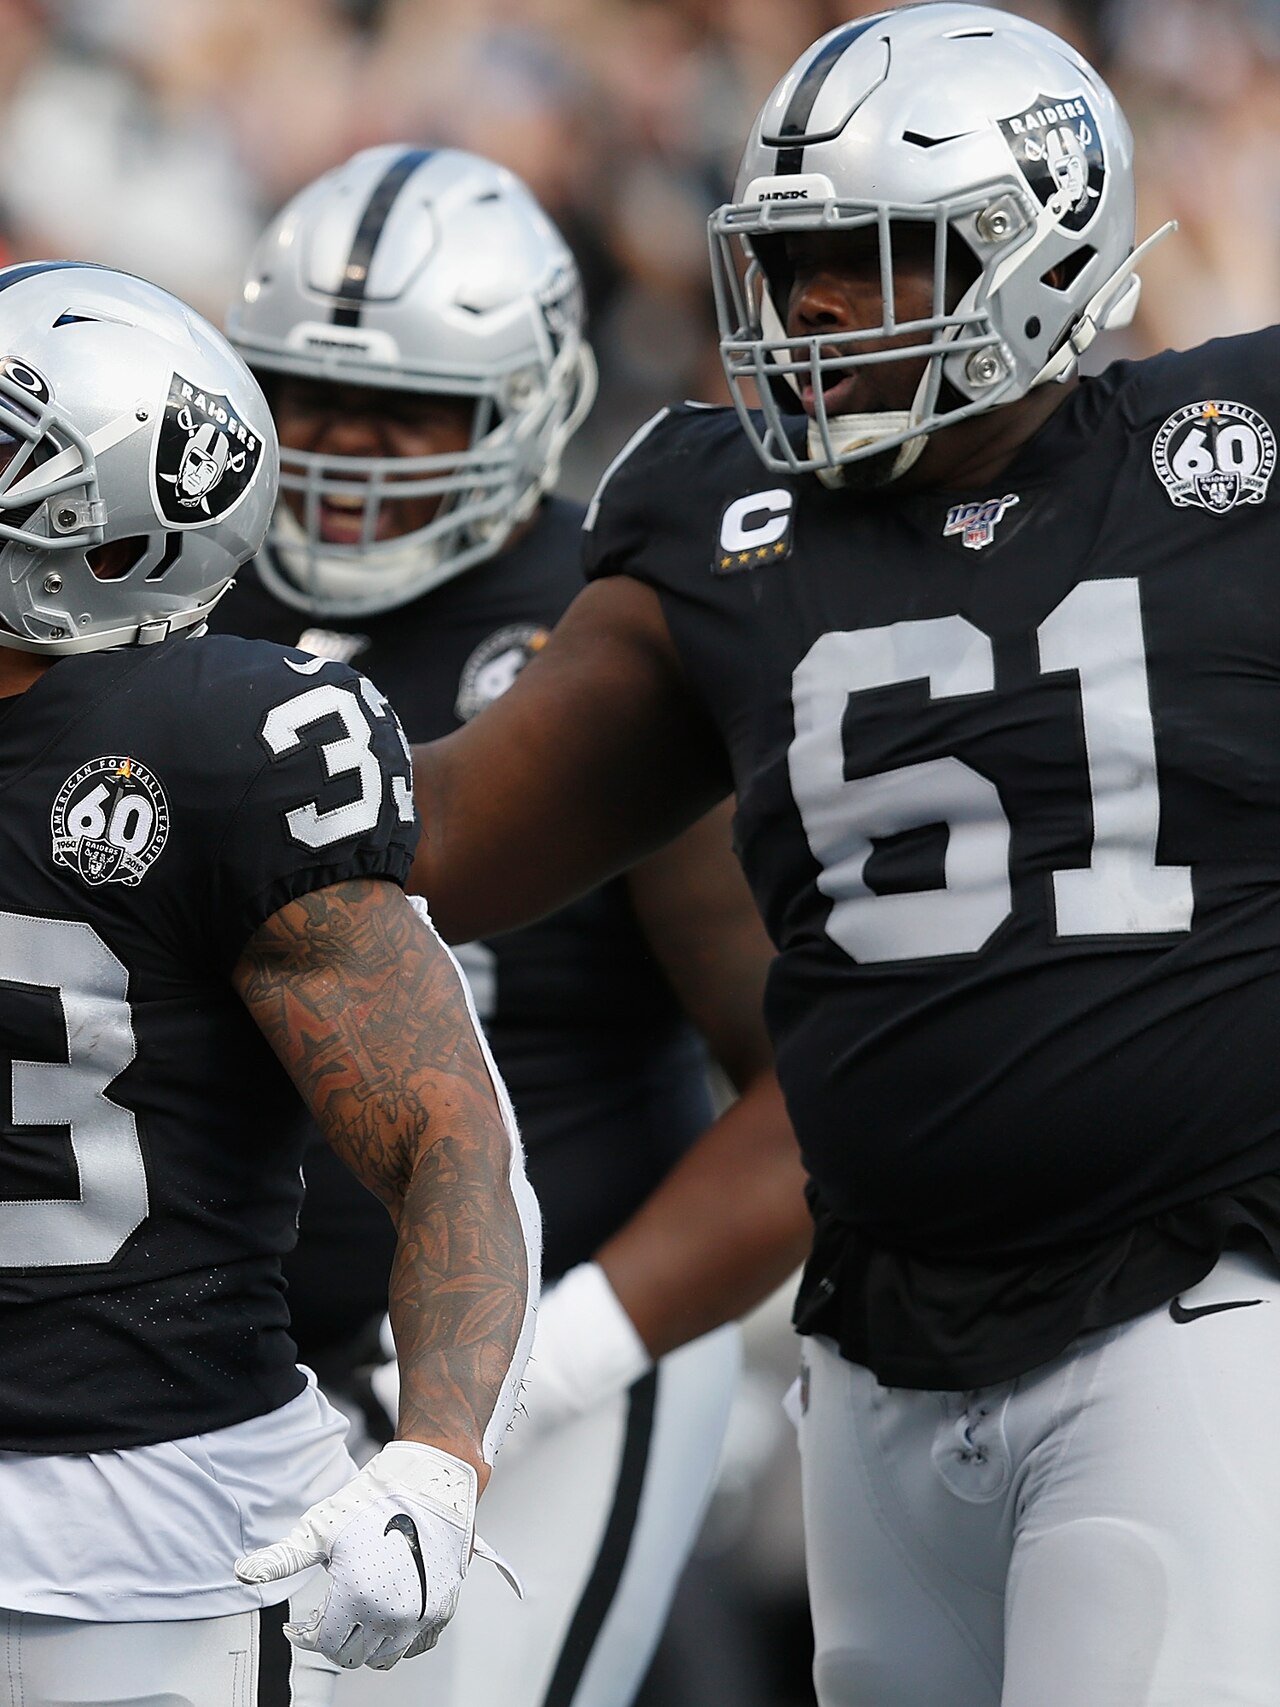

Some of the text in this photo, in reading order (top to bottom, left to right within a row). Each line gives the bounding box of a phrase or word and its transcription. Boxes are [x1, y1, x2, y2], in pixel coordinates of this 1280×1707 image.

[1009, 99, 1086, 135] RAIDERS
[181, 382, 256, 452] RAIDERS
[1172, 424, 1259, 480] 60
[720, 488, 793, 553] C
[787, 576, 1195, 965] 61
[54, 758, 168, 862] AMERICAN FOOTBALL LEAGUE
[67, 783, 154, 855] 60
[56, 839, 78, 850] 1960
[85, 841, 119, 856] RAIDERS
[125, 857, 144, 873] 2019
